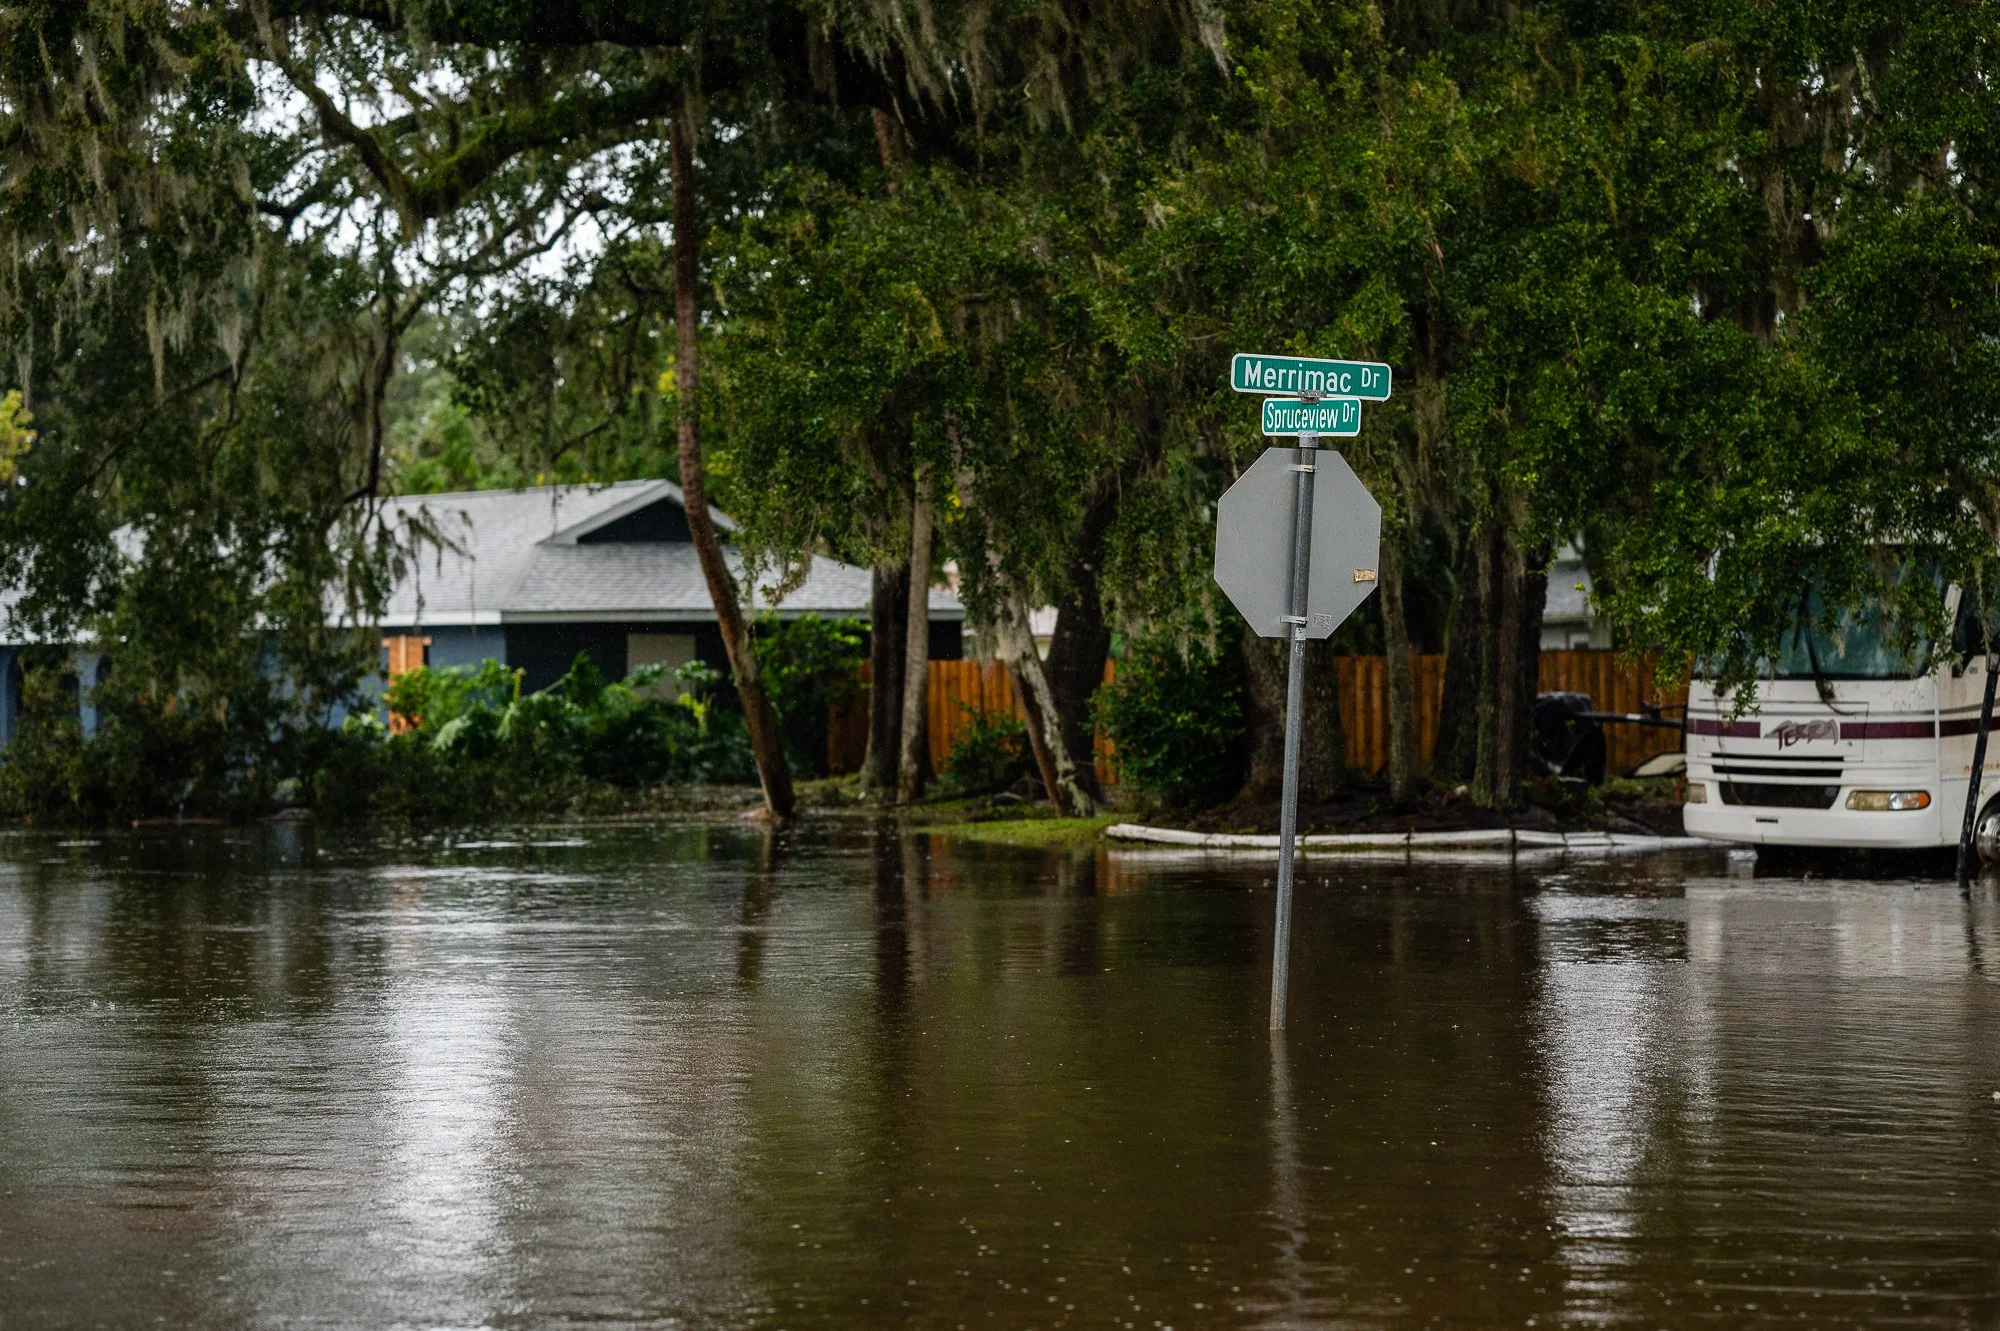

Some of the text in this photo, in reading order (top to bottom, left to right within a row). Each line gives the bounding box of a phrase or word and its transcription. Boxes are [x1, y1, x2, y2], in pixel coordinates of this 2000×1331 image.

[1244, 359, 1381, 393] Merrimac Dr
[1266, 402, 1356, 433] Spruceview Dr
